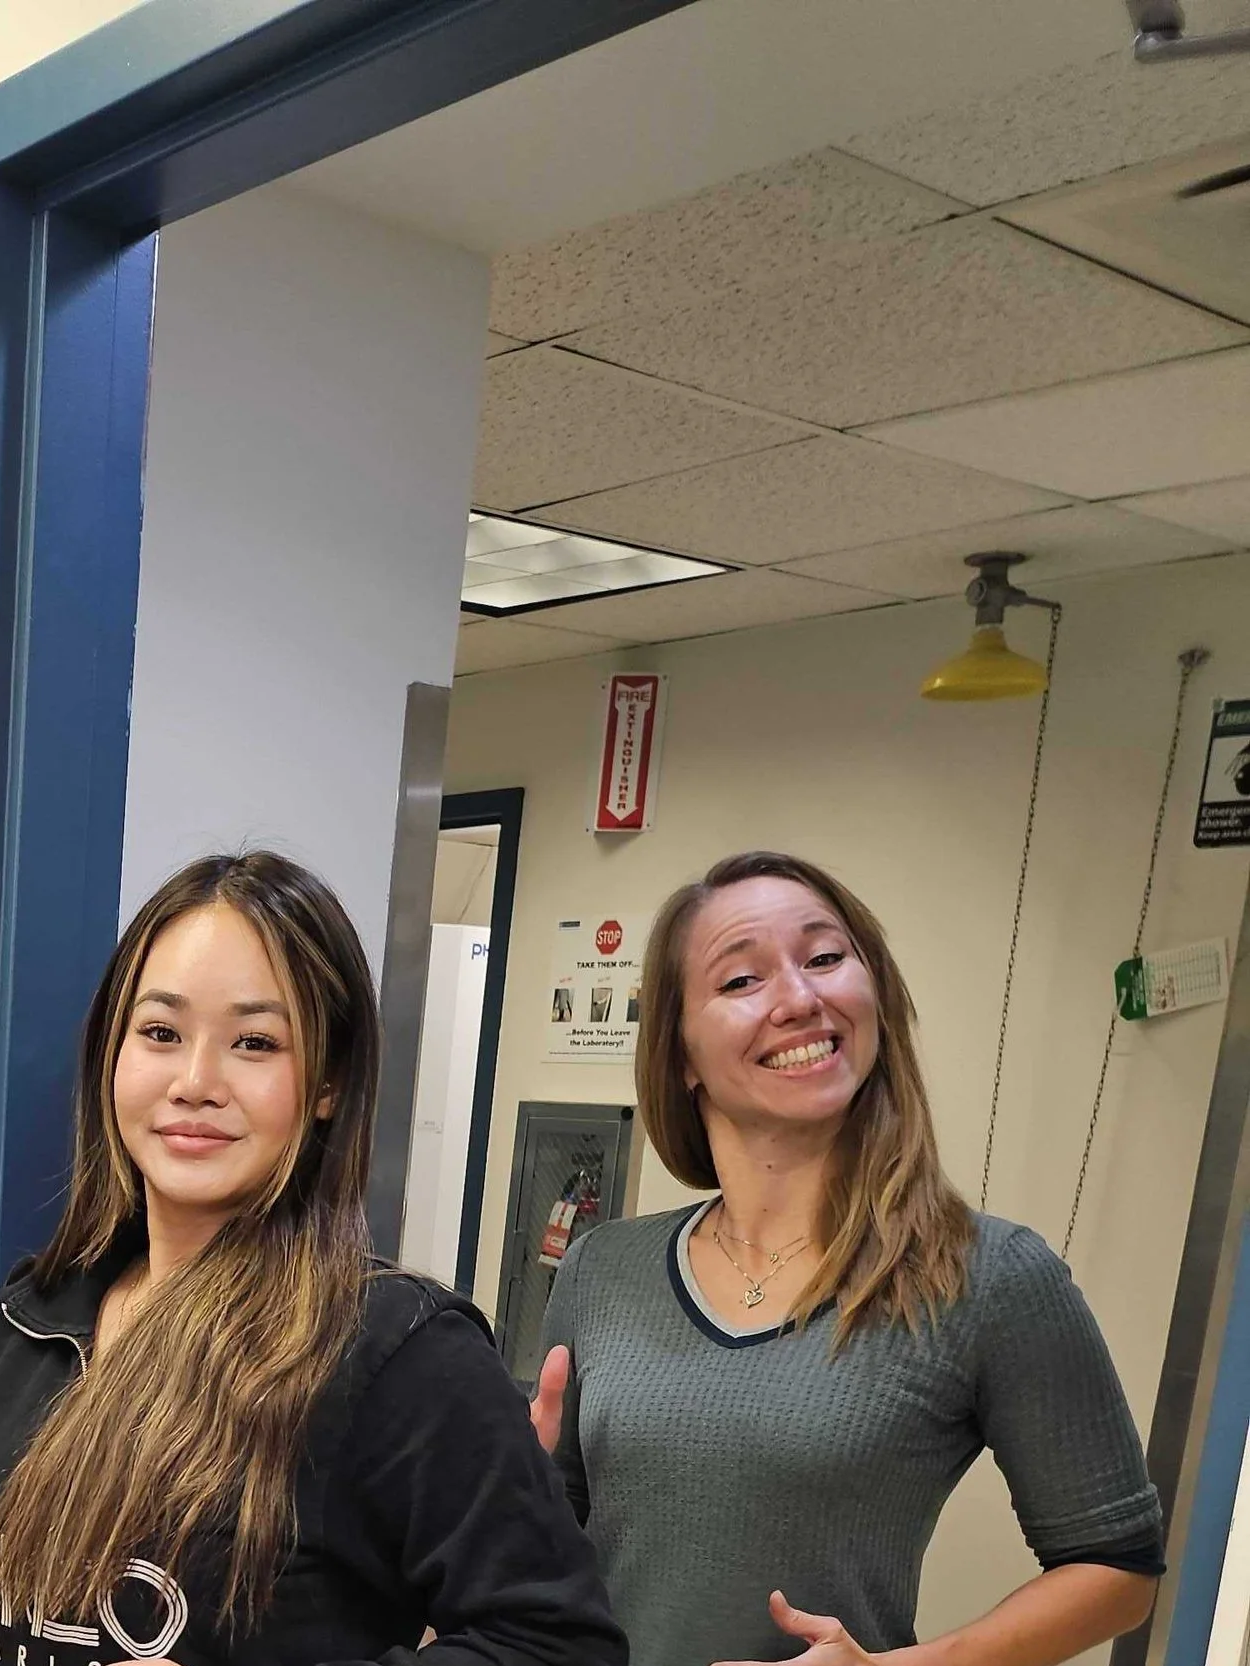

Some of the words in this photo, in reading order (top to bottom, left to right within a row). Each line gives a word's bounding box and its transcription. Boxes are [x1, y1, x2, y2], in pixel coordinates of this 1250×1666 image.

[617, 690, 650, 702] FIRE
[617, 703, 637, 810] EXTINGUISHER
[597, 930, 621, 945] STOP
[576, 961, 595, 969] TAKE
[597, 961, 617, 969] THEM
[596, 1029, 608, 1037] You
[610, 1029, 631, 1037] Leave
[569, 1039, 581, 1047] the
